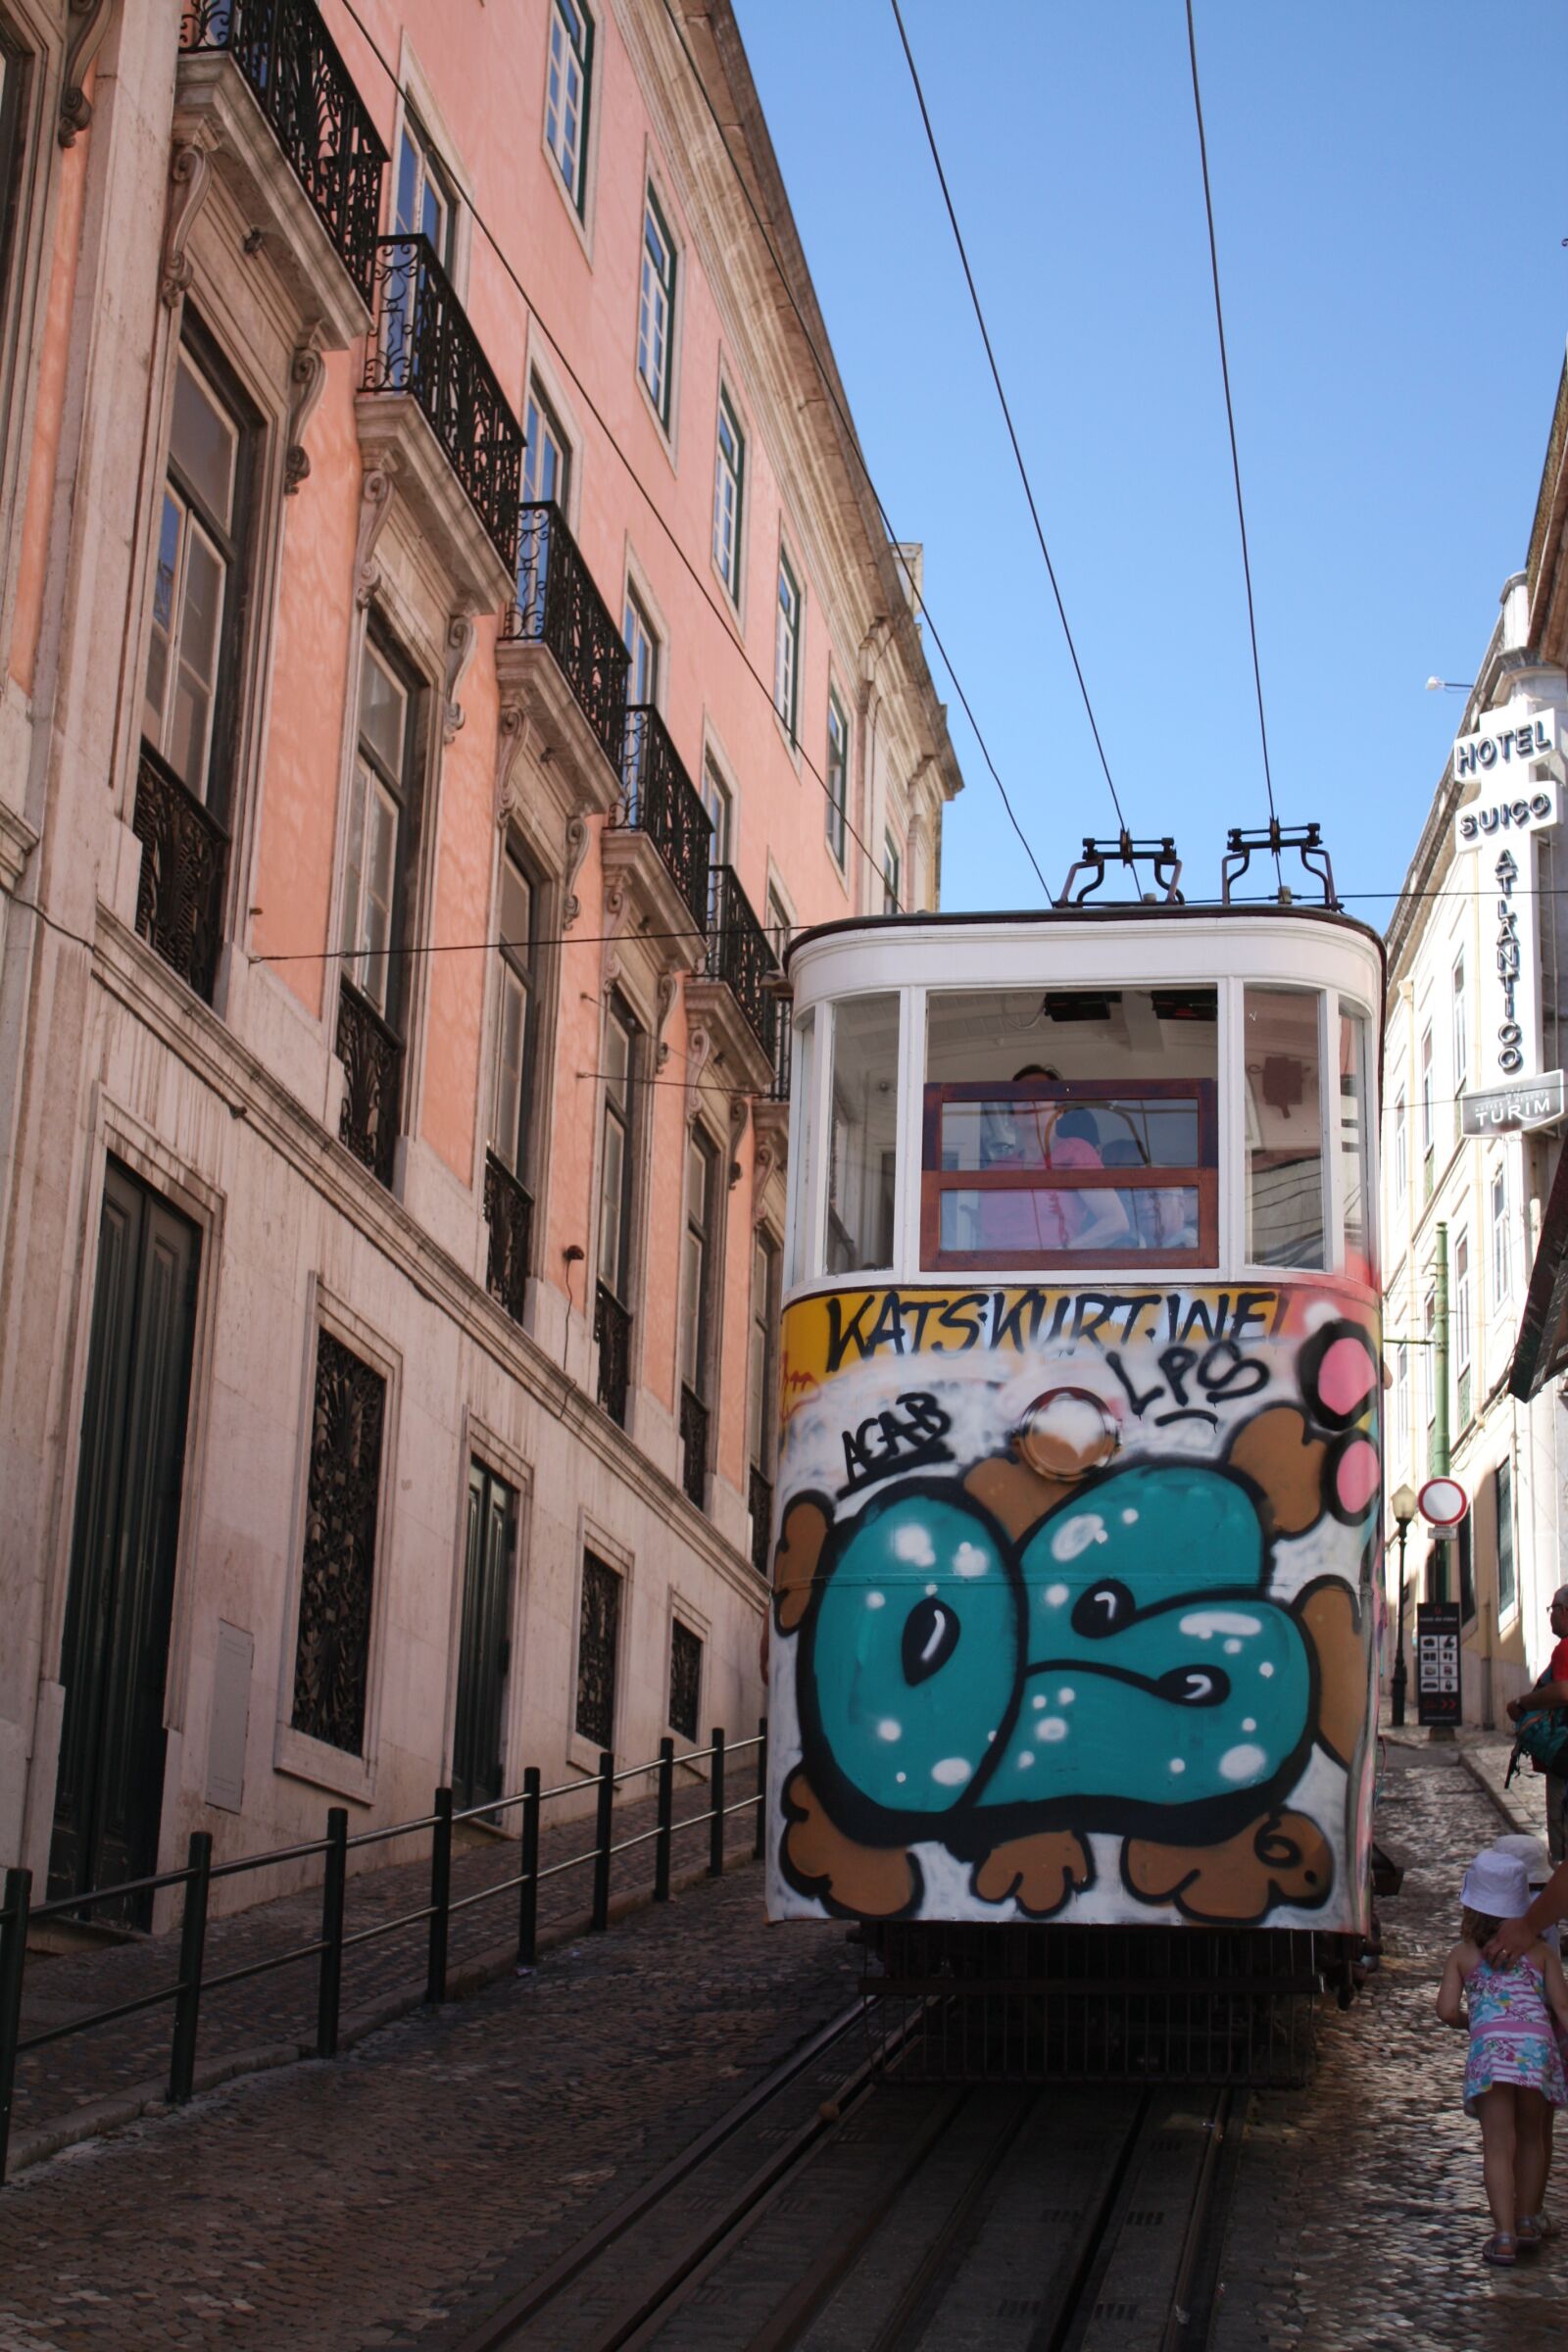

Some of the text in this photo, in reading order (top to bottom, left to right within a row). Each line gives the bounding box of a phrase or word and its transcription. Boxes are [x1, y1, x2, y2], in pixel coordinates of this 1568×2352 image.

[1457, 721, 1551, 774] HOTEL
[1476, 1098, 1549, 1126] TURIM
[1105, 1340, 1270, 1417] LPS
[842, 1392, 953, 1486] ACAB
